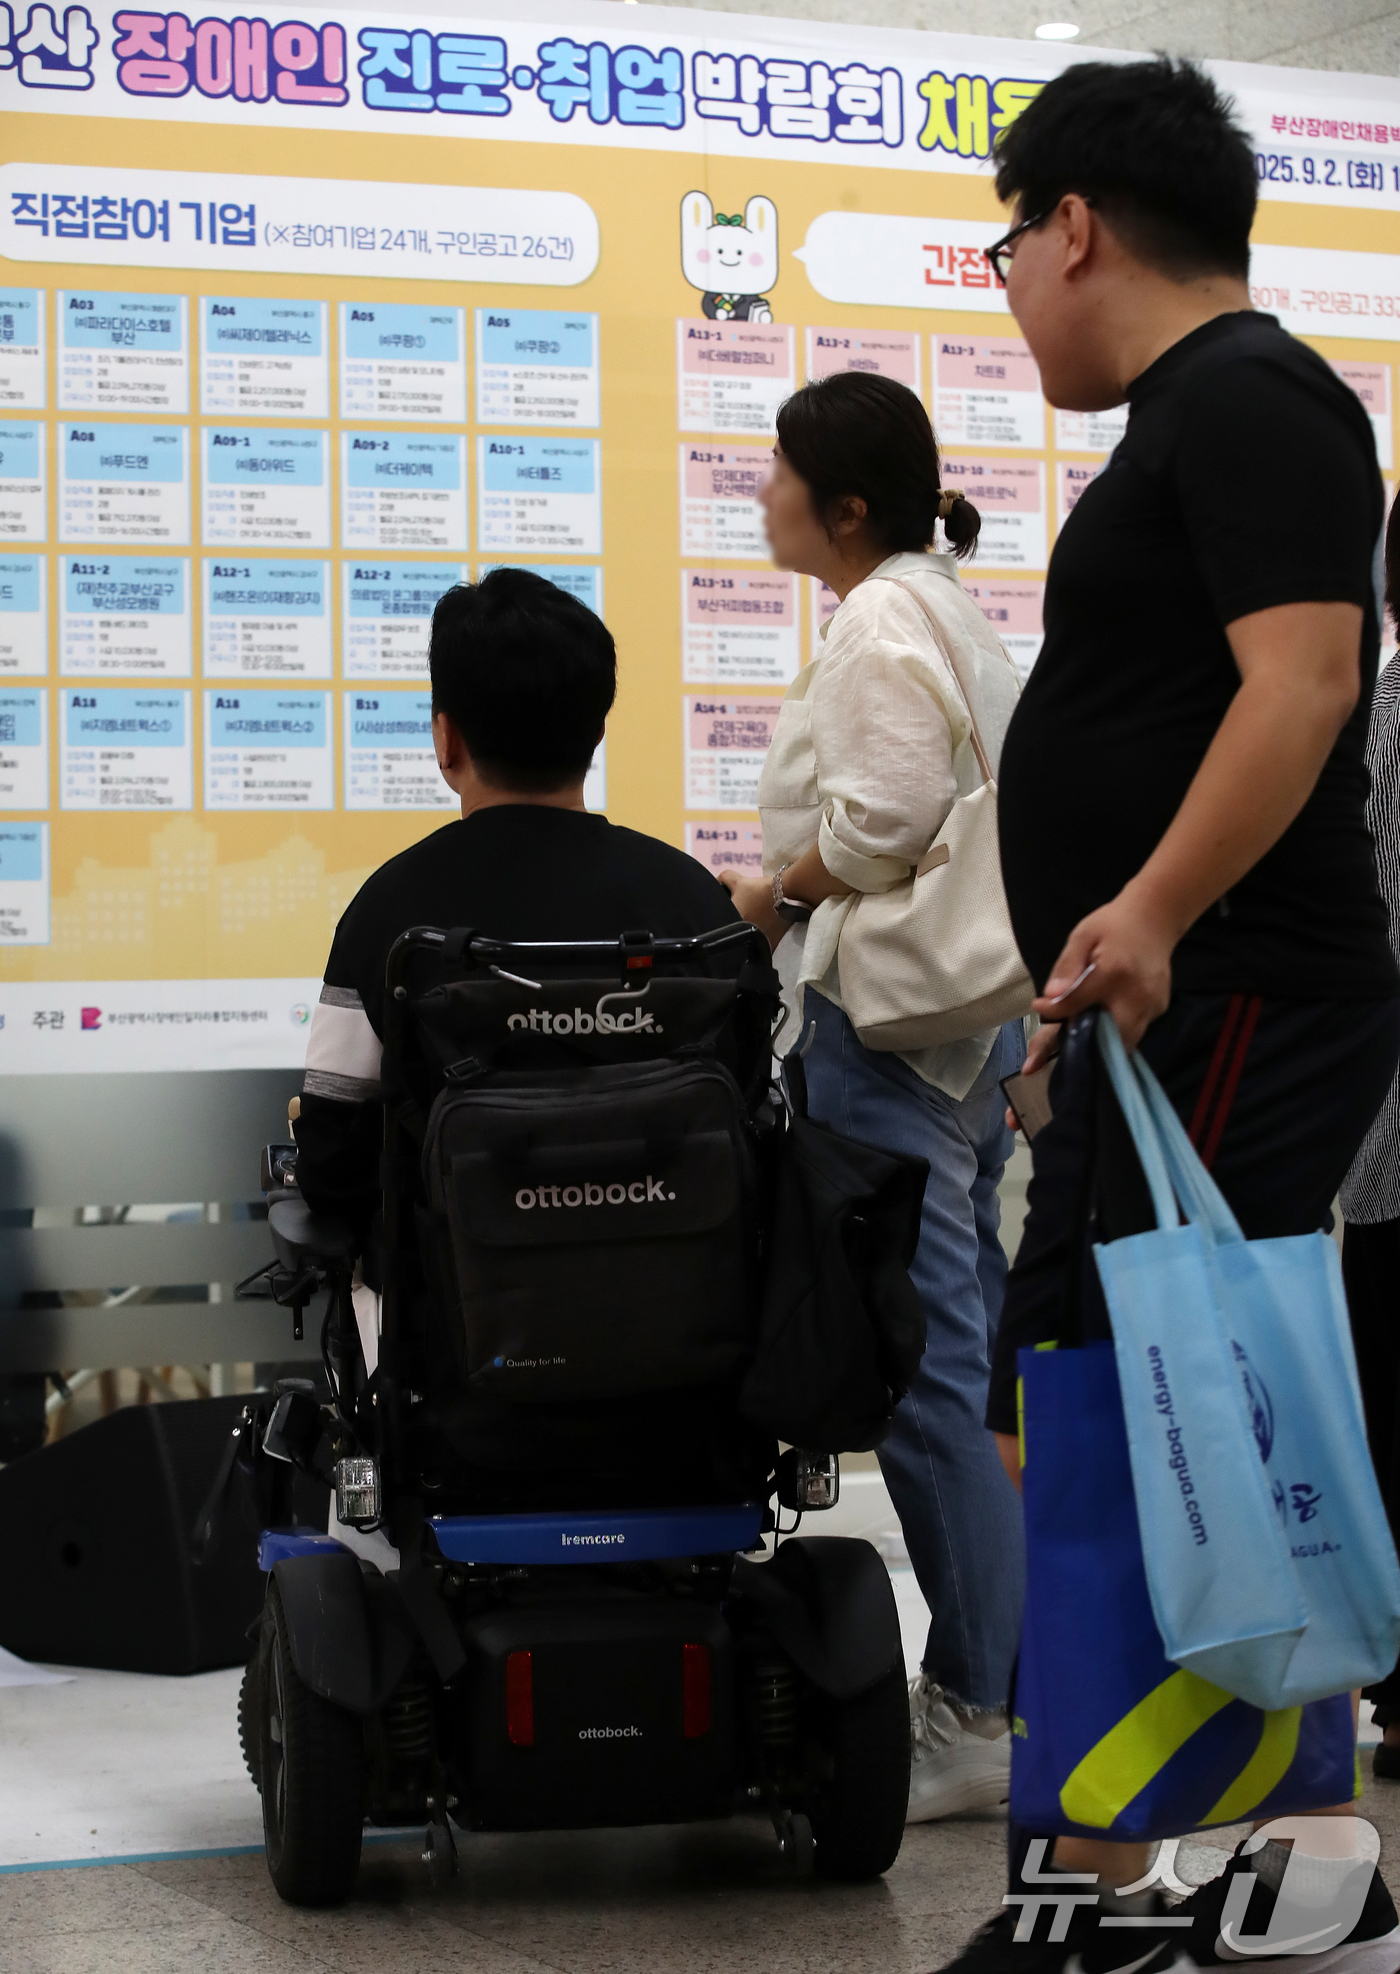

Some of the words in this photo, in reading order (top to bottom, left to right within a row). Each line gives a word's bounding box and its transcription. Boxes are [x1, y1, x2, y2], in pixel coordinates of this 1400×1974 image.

[112, 10, 349, 106] 장애인
[358, 27, 685, 130] 진로·취업
[692, 49, 904, 147] 박람회
[11, 192, 170, 242] 직접참여
[179, 201, 256, 247] 기업
[381, 228, 432, 254] 24개,
[436, 231, 517, 257] 구인공고
[522, 236, 575, 261] 26건)
[70, 298, 94, 310] A03
[1300, 289, 1370, 315] 구인공고
[111, 332, 136, 346] 부산
[688, 328, 723, 341] A13-1
[32, 1010, 65, 1029] 주관
[515, 1175, 676, 1210] ottobock.
[506, 1359, 537, 1368] Quality
[539, 1358, 551, 1366] for
[553, 1357, 566, 1365] life
[1147, 1344, 1208, 1547] energy-bagua.com
